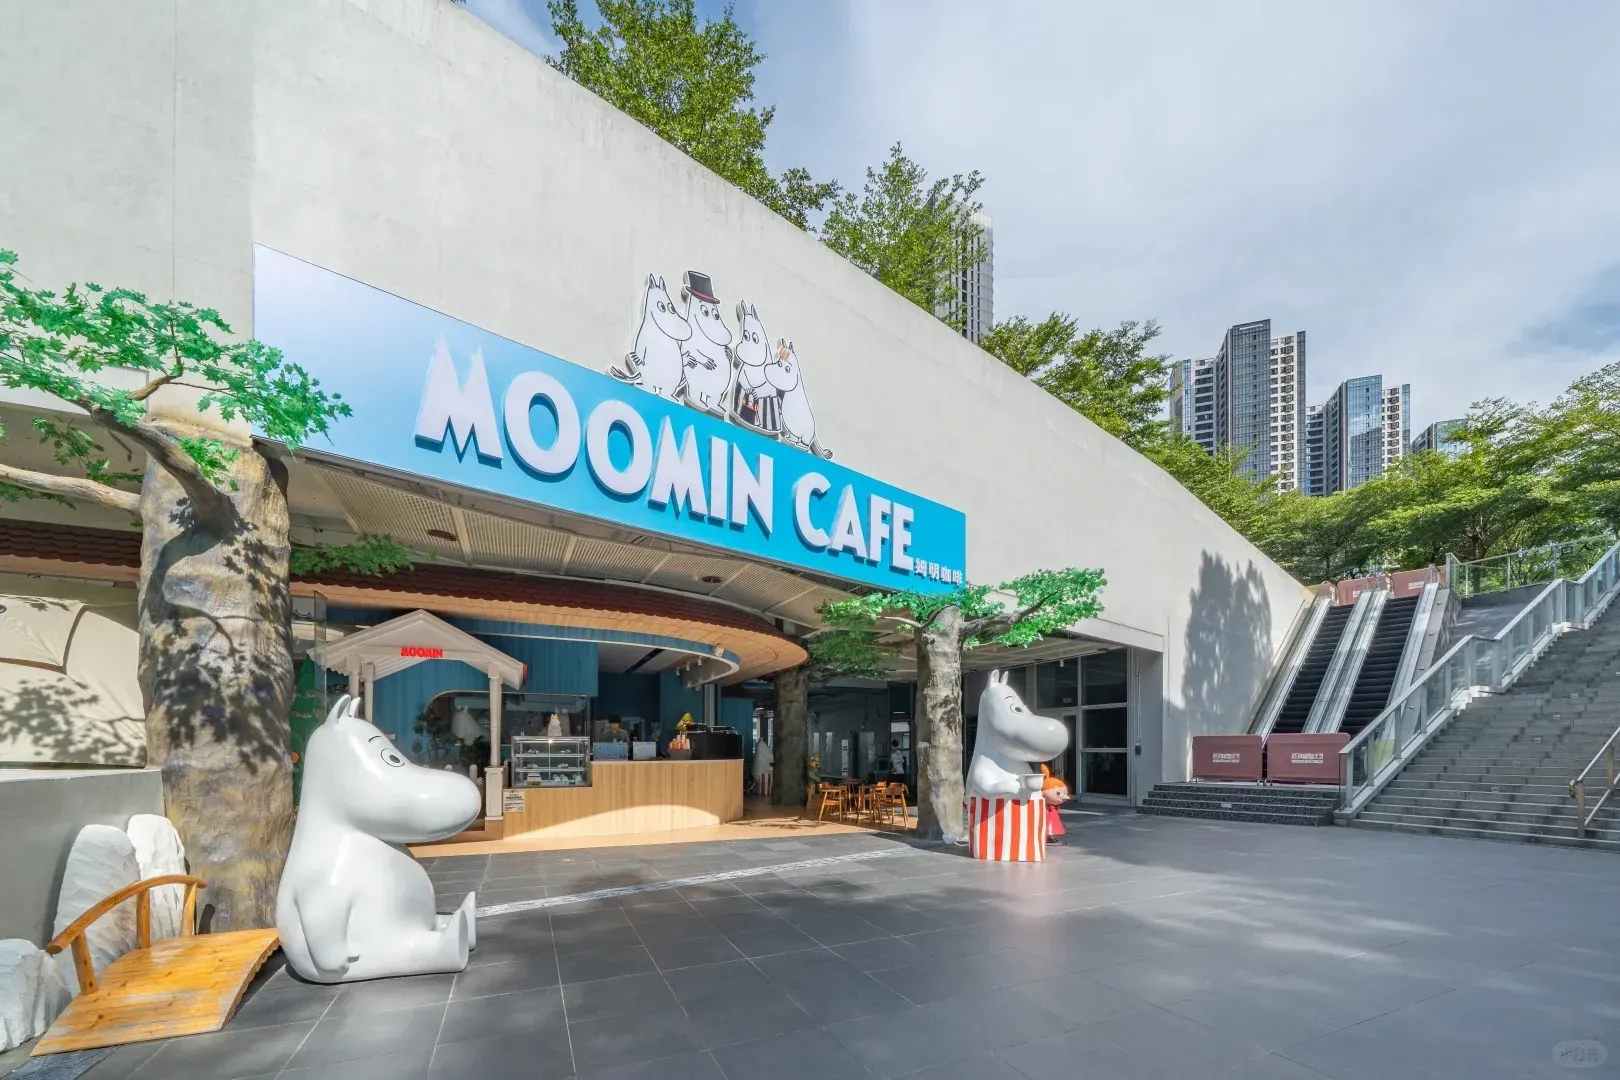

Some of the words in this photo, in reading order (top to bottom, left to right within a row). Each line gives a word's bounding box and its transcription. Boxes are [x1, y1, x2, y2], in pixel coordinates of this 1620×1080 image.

[415, 333, 774, 534] MOOMIN
[793, 472, 915, 571] CAFE
[914, 558, 963, 585] 姆明咖啡
[400, 646, 443, 658] MOOMIN
